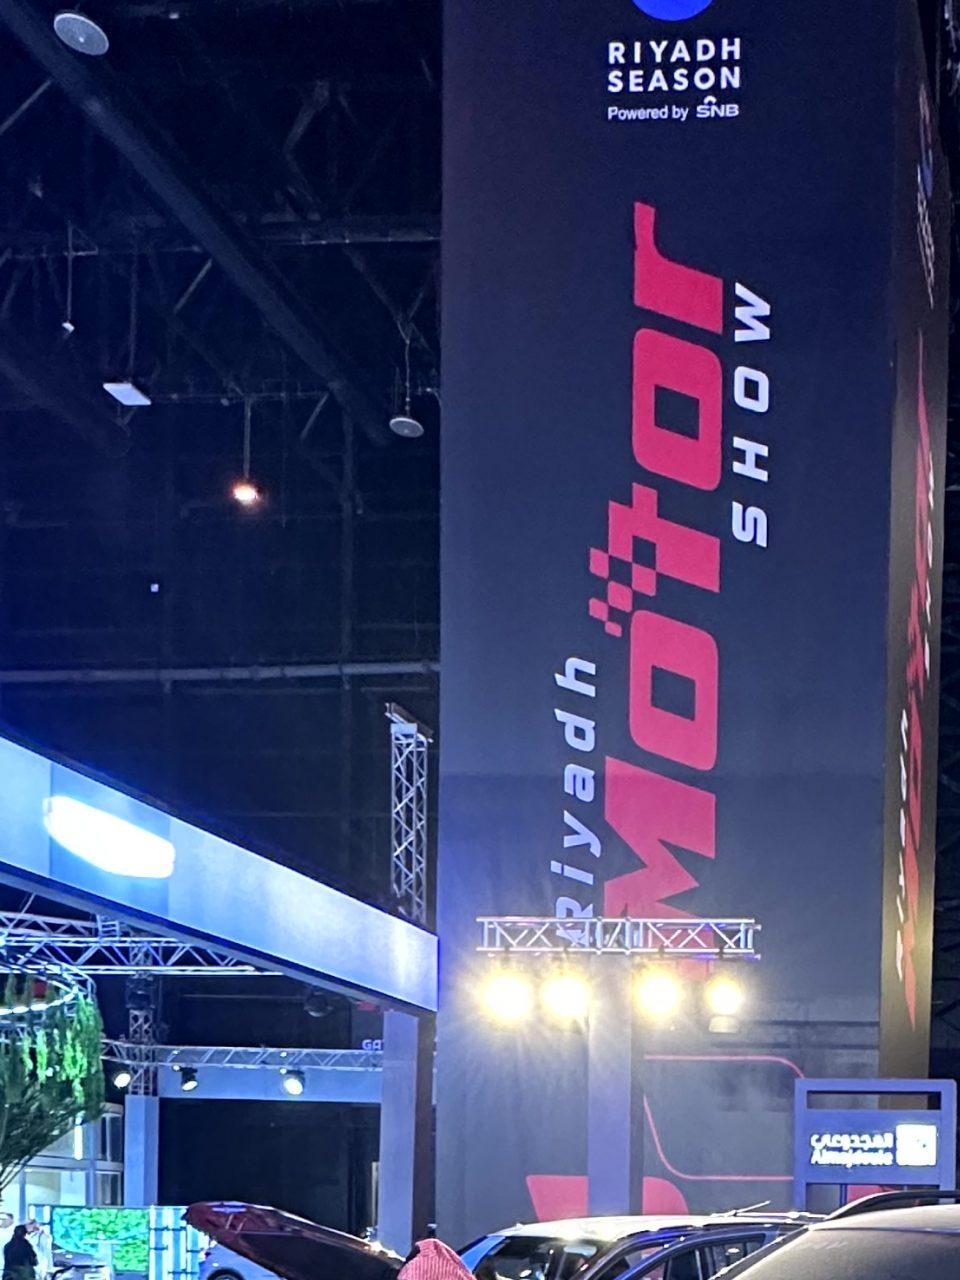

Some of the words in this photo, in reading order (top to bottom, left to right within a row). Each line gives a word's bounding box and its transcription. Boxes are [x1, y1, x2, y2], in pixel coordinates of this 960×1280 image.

[608, 37, 741, 64] RIYADH
[607, 66, 741, 93] SEASON
[608, 105, 668, 121] Powered
[671, 105, 689, 122] by
[696, 101, 739, 118] SNB
[732, 282, 771, 547] SHOW
[550, 656, 601, 946] Riyadh
